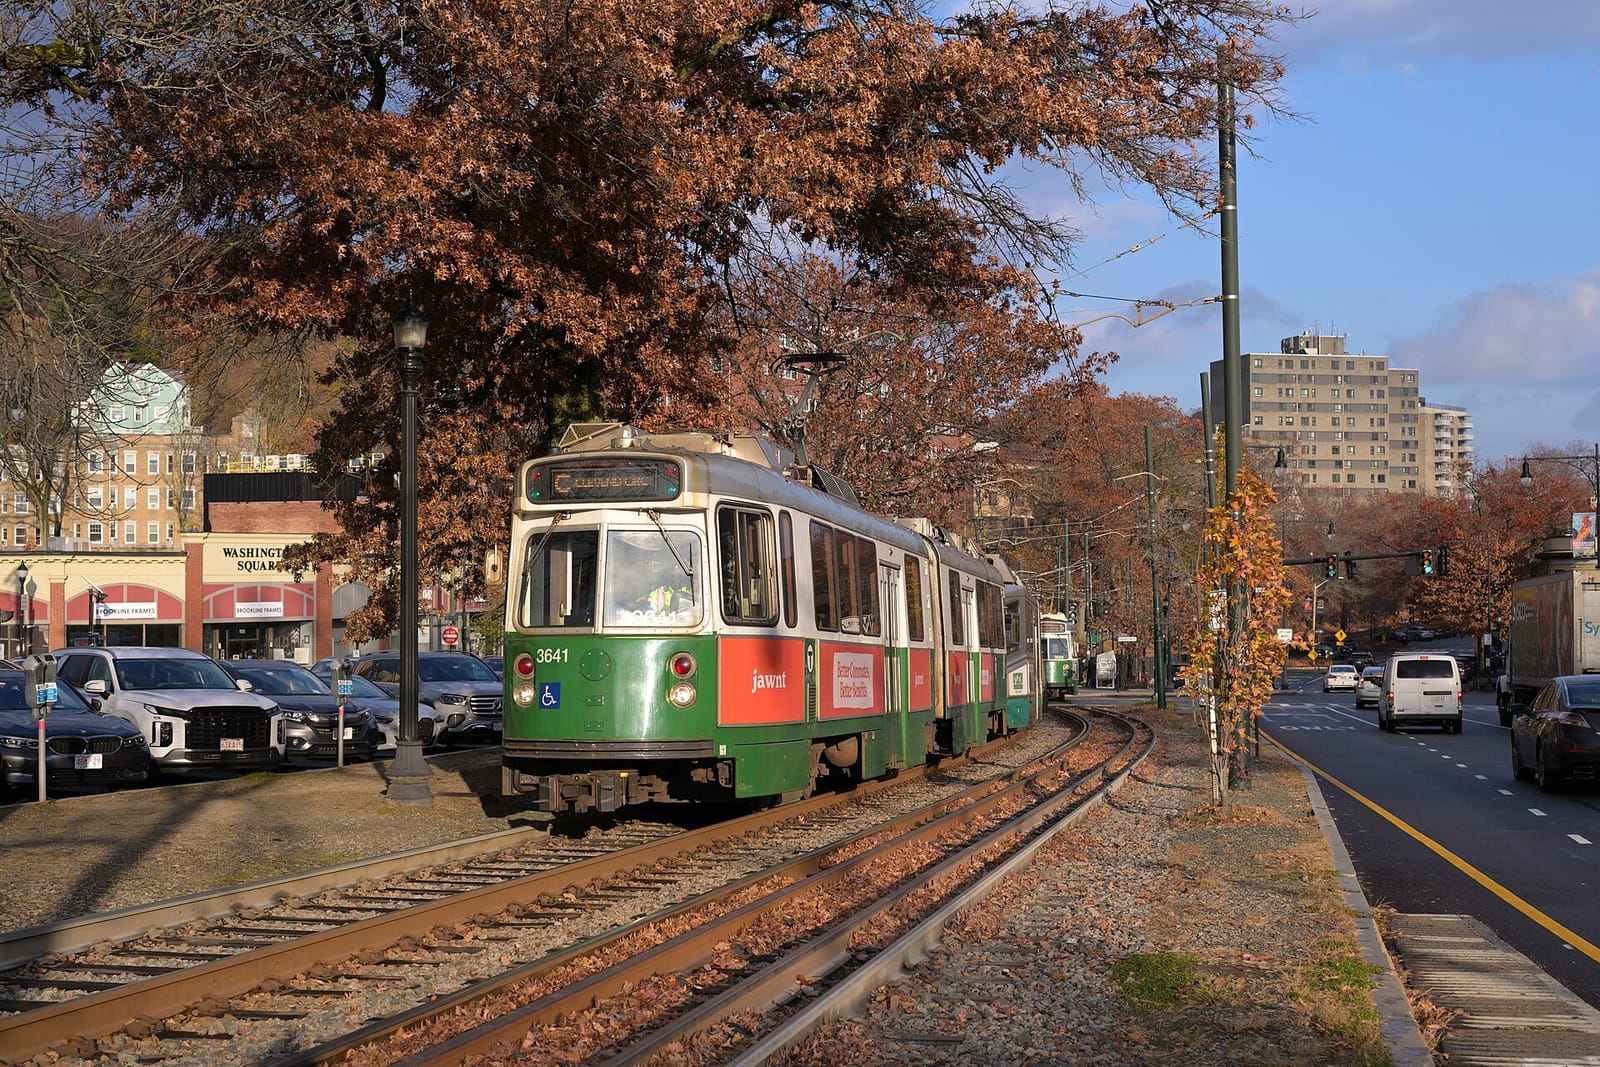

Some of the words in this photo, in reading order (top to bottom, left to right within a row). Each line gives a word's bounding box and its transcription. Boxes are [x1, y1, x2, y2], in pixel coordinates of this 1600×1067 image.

[554, 474, 571, 493] C
[223, 548, 283, 558] WASHINGT
[237, 560, 277, 572] SQUAR
[536, 648, 569, 663] 3641
[751, 669, 787, 694] jawnt
